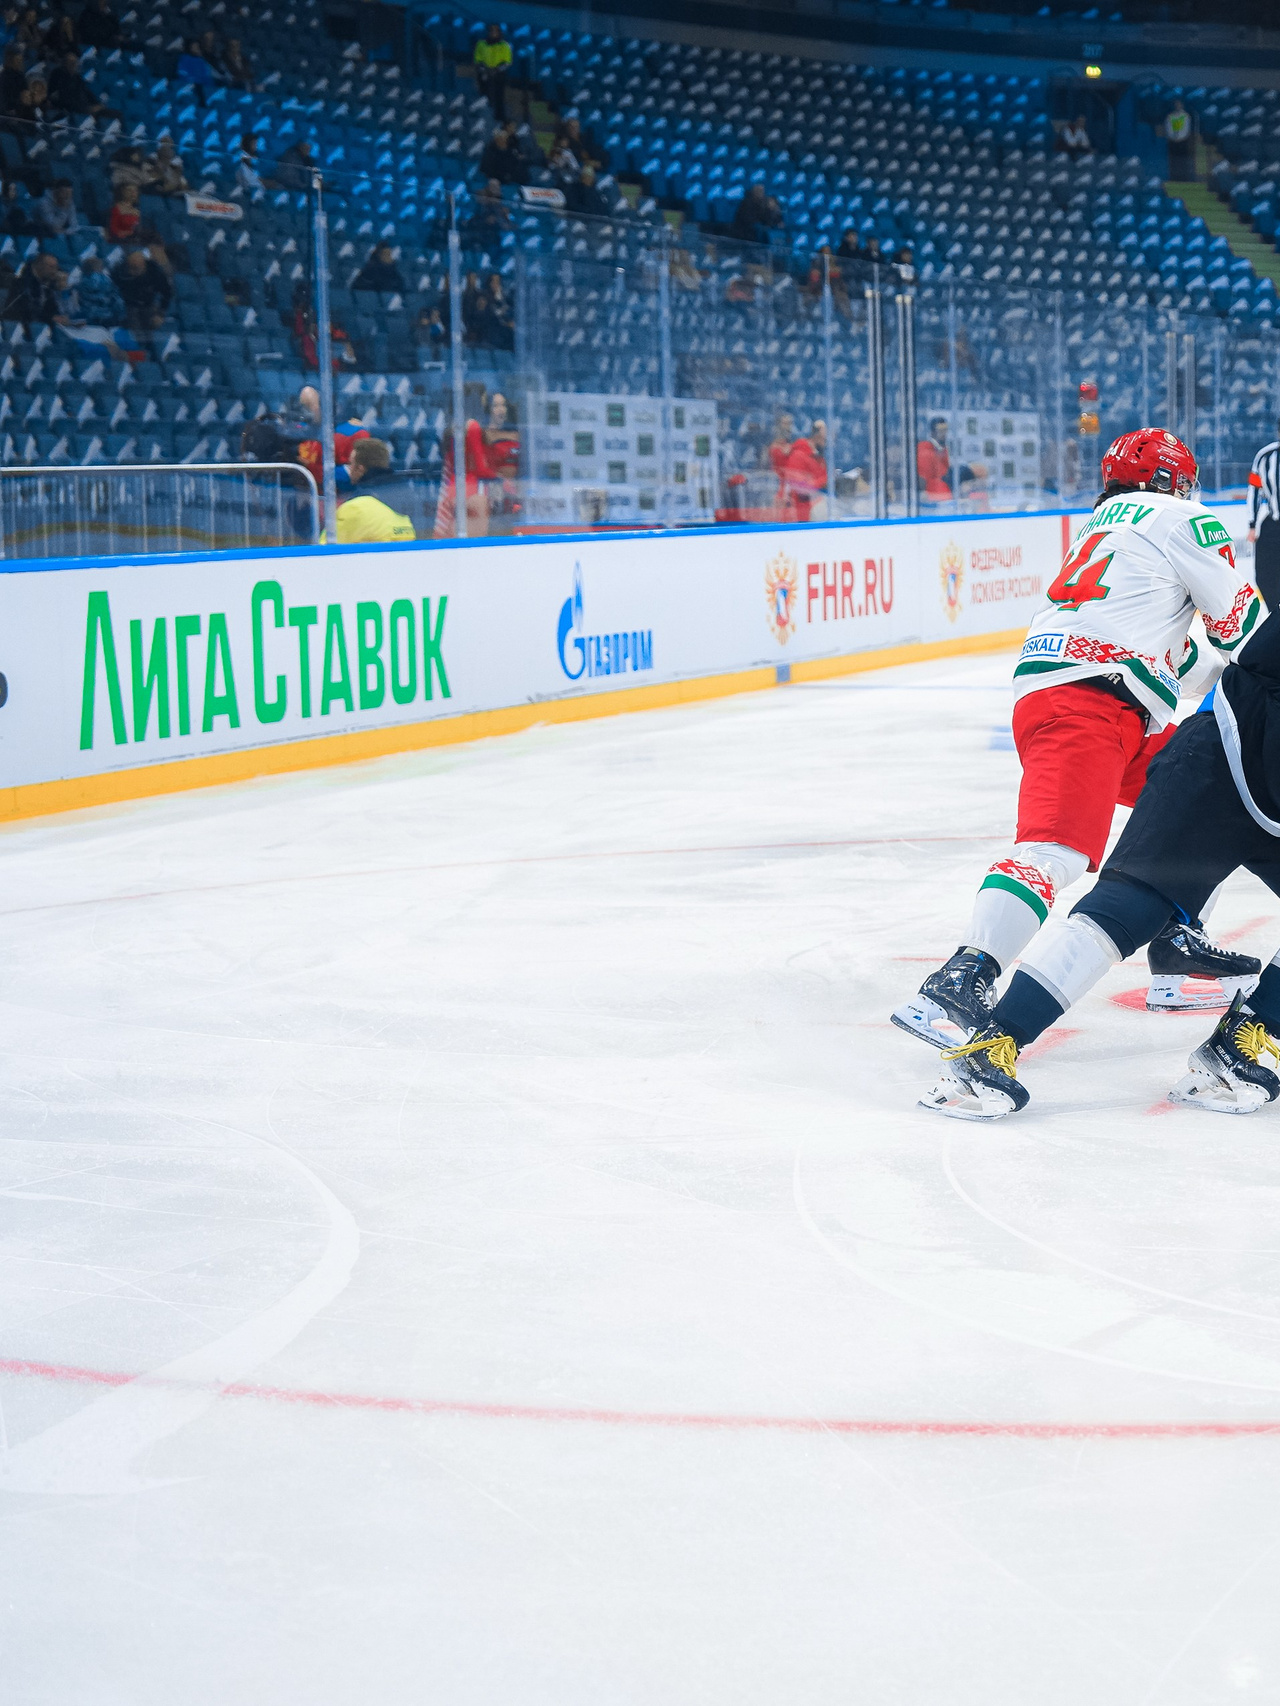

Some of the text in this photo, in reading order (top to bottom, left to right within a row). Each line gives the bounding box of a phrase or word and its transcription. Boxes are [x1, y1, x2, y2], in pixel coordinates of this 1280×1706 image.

[1159, 456, 1179, 467] CCM
[1077, 502, 1155, 541] HAREV
[806, 557, 893, 623] FHR.RU
[586, 629, 653, 678] ГАЗПРОМ
